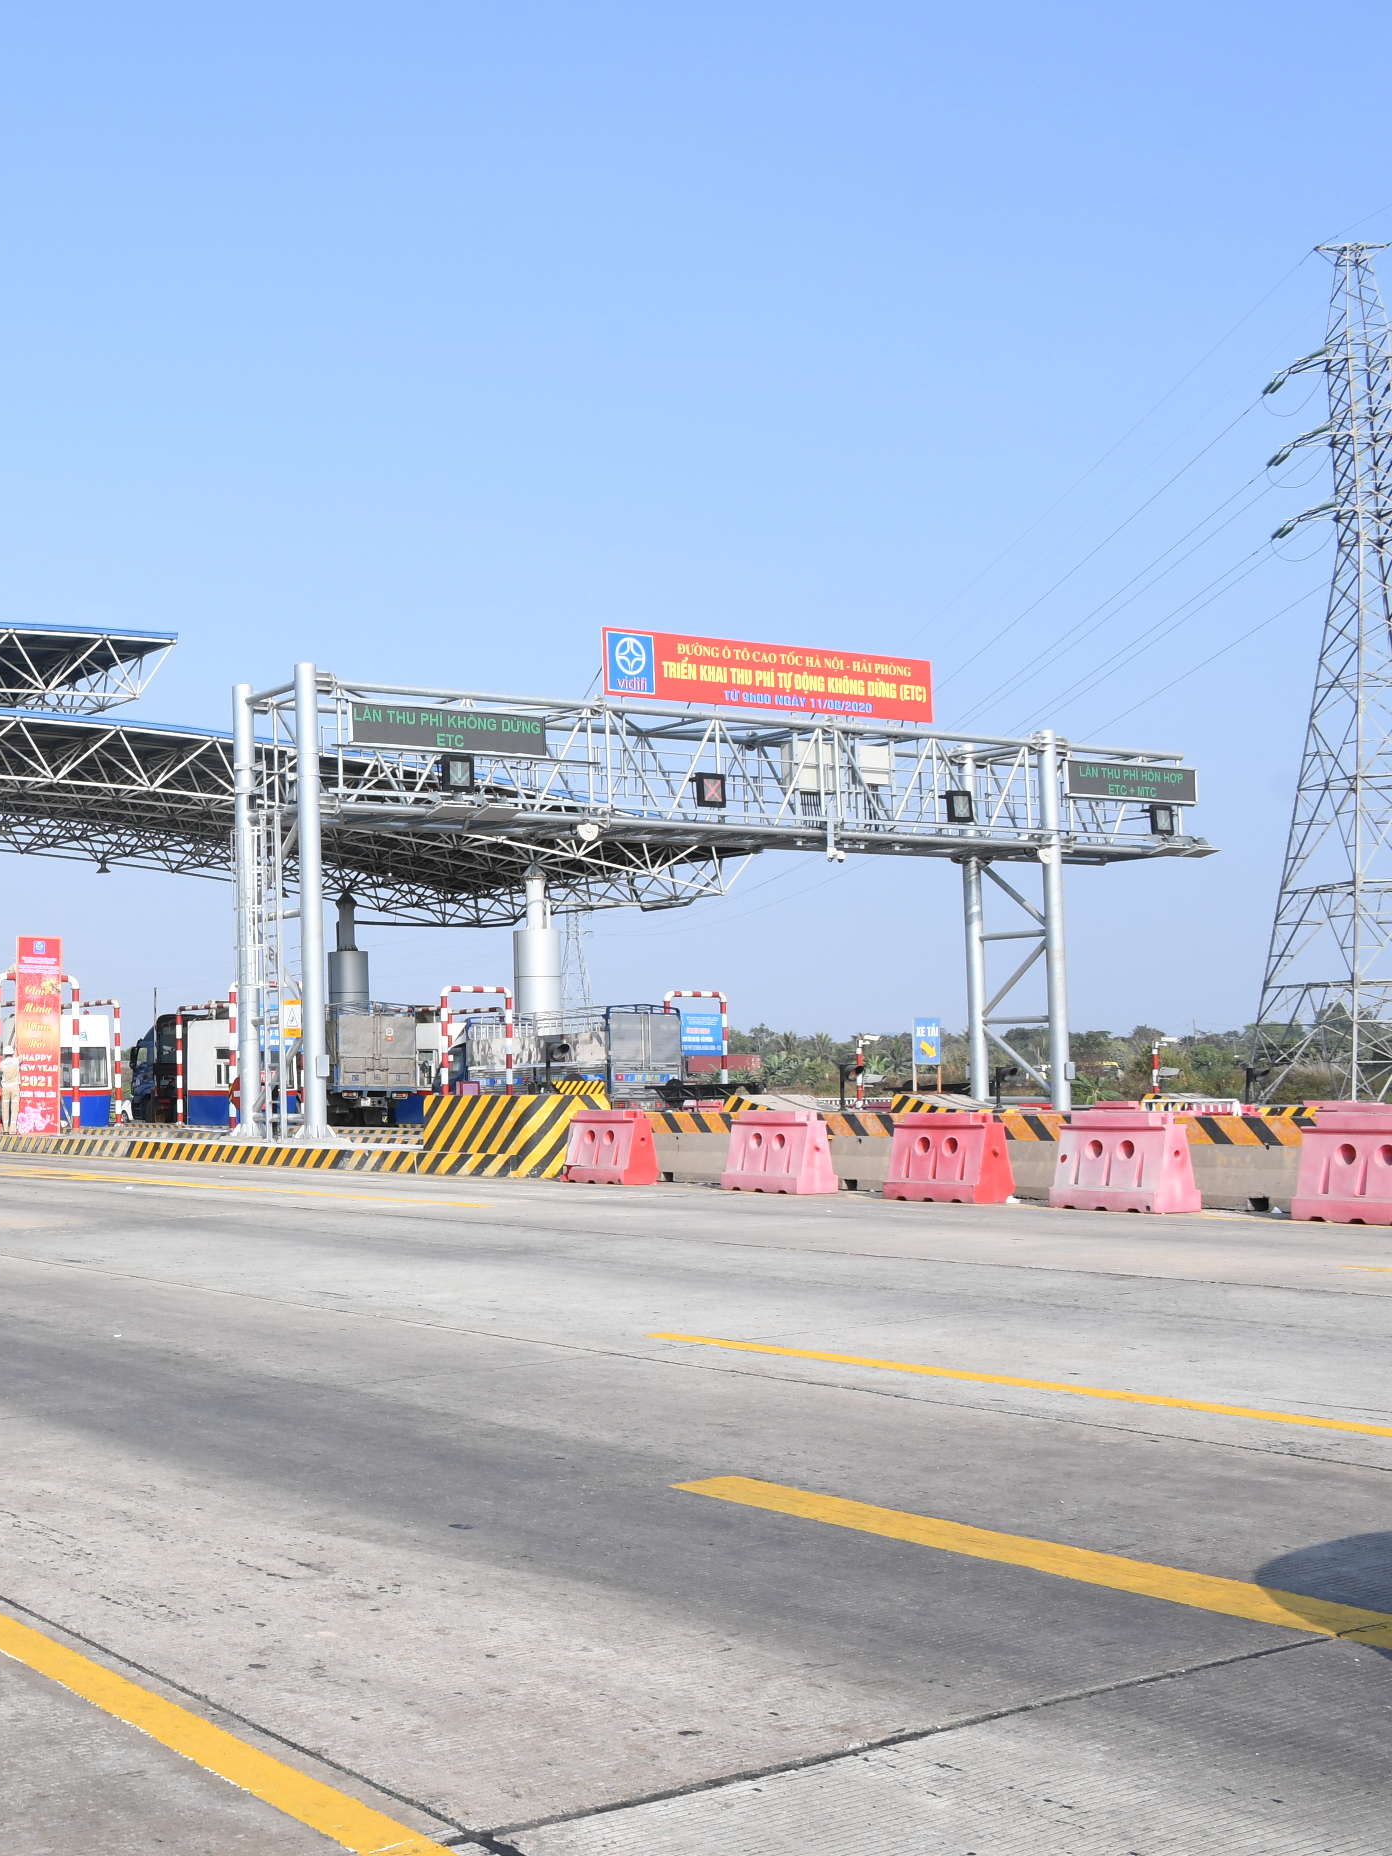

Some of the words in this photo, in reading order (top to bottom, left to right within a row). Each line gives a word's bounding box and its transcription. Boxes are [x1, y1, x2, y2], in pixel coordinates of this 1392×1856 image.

[677, 642, 720, 658] ĐƯỜNG
[722, 646, 732, 660] Ô
[733, 647, 750, 661] TÔ
[752, 651, 778, 664] CAO
[779, 650, 803, 666] TỐC
[805, 654, 821, 668] HÀ
[824, 656, 845, 672] NỘI
[852, 658, 873, 674] HẢI
[874, 662, 912, 678] PHÒNG
[617, 675, 647, 692] vidifi
[661, 656, 697, 681] TRIỂN
[699, 666, 728, 684] KHAI
[730, 667, 753, 686] THU
[755, 668, 775, 688] PHÍ
[777, 671, 793, 693] TỰ
[794, 671, 825, 695] ĐỘNG
[827, 675, 866, 696] KHÔNG
[867, 677, 897, 700] DỪNG
[899, 684, 927, 703] (ETC)
[724, 687, 740, 702] TỪ
[742, 691, 772, 704] 9h00
[774, 693, 807, 707] NGÀY
[353, 705, 382, 723] LÀN
[387, 710, 416, 725] THU
[420, 710, 443, 728] PHÍ
[447, 713, 497, 731] KHÔNG
[501, 717, 541, 735] DỪNG
[436, 733, 465, 748] ETC
[1079, 764, 1098, 778] LÀN
[1101, 767, 1121, 779] THU
[1123, 767, 1139, 781] PHÍ
[1163, 773, 1184, 787] HỢP
[1108, 784, 1127, 796] ETC
[1137, 785, 1157, 797] MTC
[916, 1026, 926, 1037] XE
[927, 1022, 939, 1037] TẢI
[22, 1053, 53, 1062] HAPPY
[37, 1064, 58, 1072] YEAR
[21, 1075, 53, 1087] 2021
